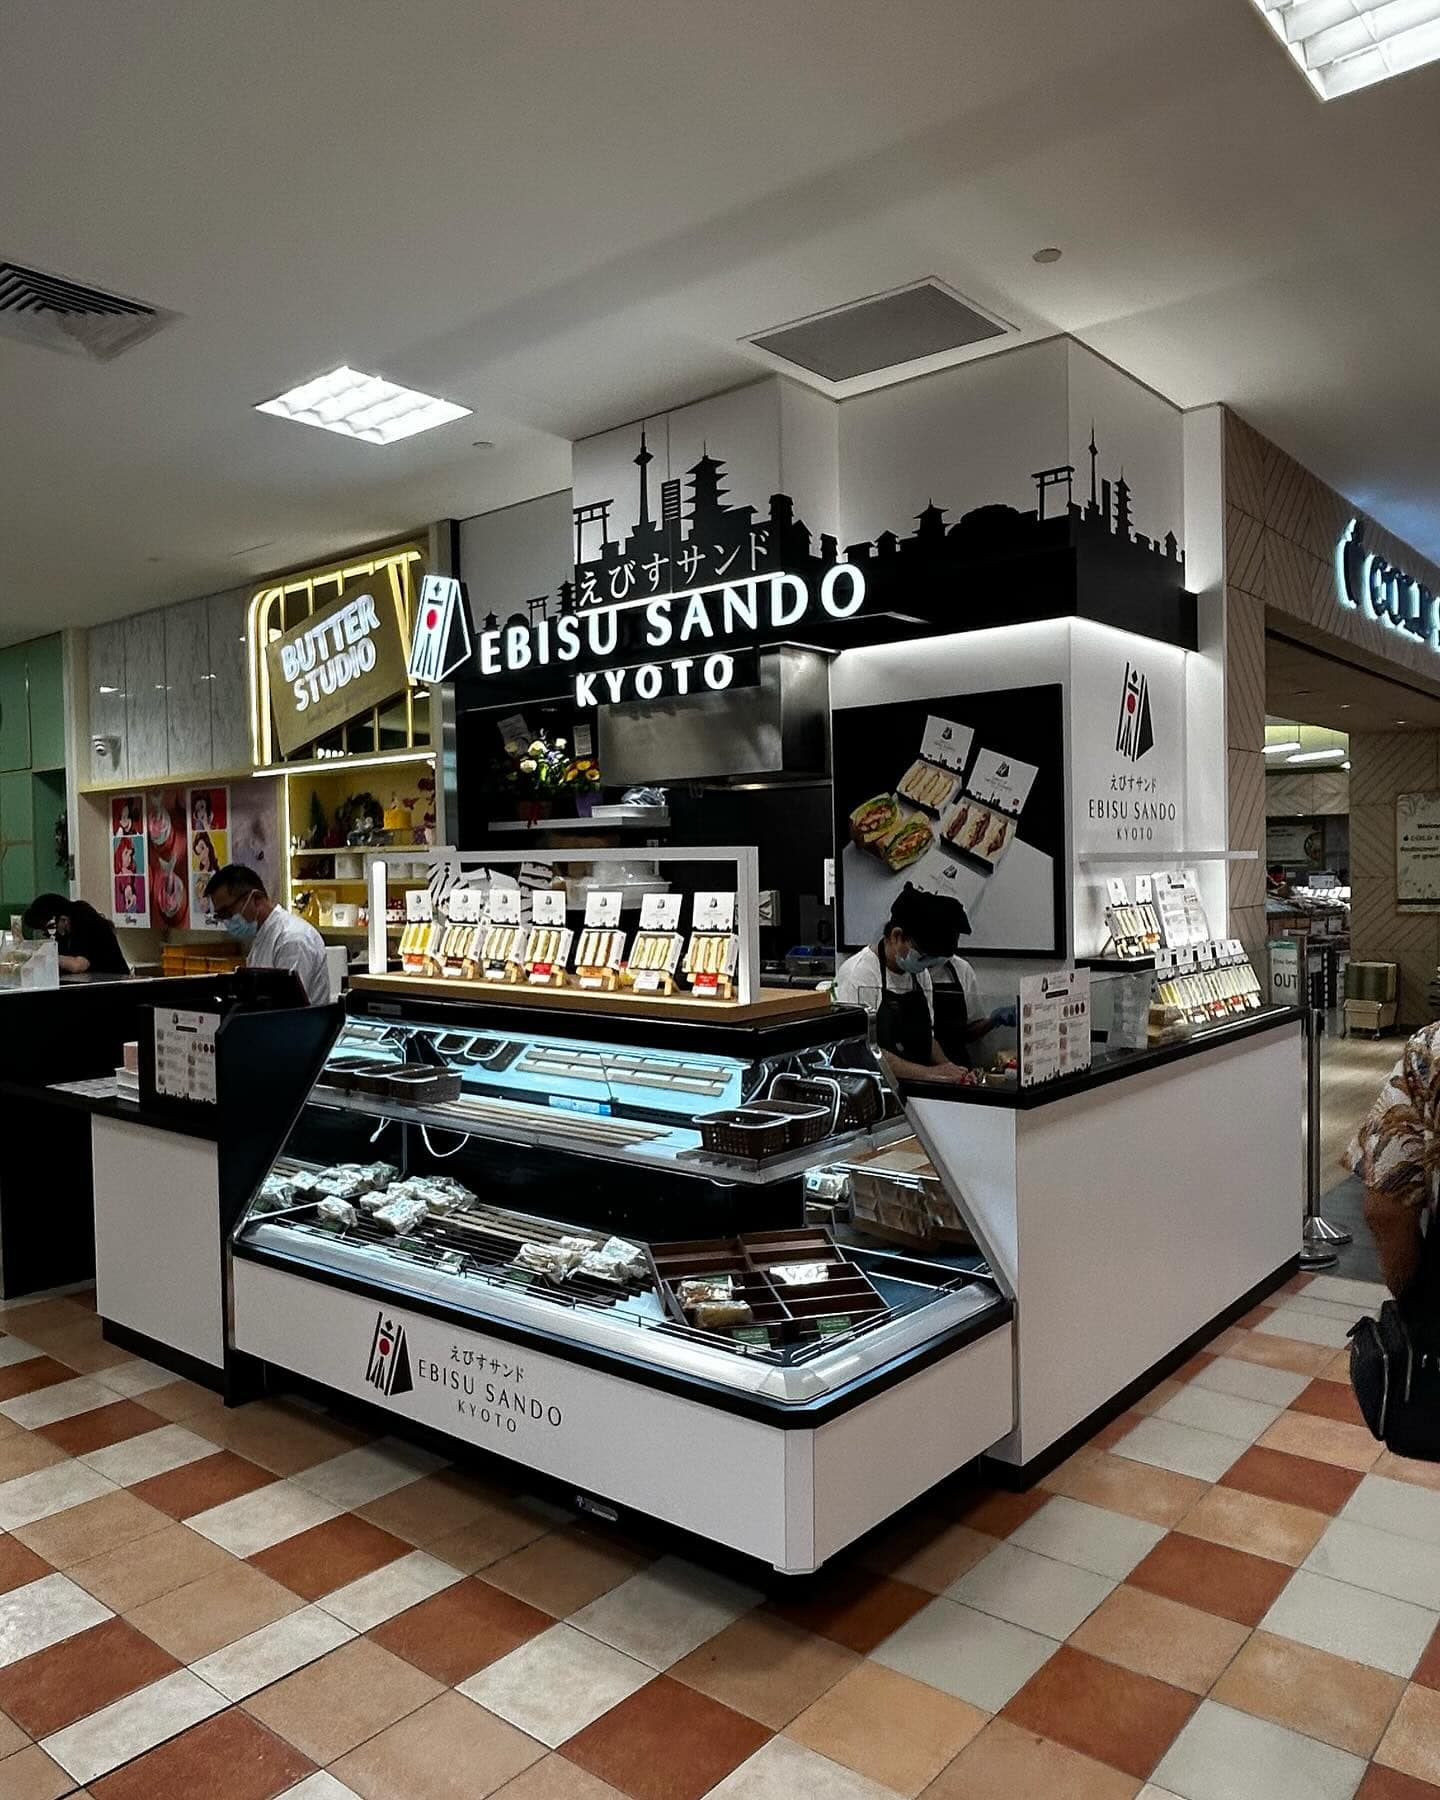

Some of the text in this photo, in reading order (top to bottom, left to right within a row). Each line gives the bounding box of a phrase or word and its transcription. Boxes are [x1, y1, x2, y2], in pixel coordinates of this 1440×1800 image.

[578, 530, 770, 607] えびすサンド
[280, 594, 381, 683] BUTTER
[480, 563, 867, 676] EBISU SANDO
[294, 637, 377, 712] STUDIO
[575, 653, 735, 708] KYOTO
[1110, 773, 1157, 794] えびすサンド
[1089, 799, 1176, 822] EBISU SANDO
[1116, 827, 1153, 841] KYOTO
[1274, 972, 1297, 989] OUT
[450, 1345, 524, 1383] えびすサンド
[418, 1358, 562, 1427] EBISU SANDO
[458, 1400, 517, 1433] KYOTO
